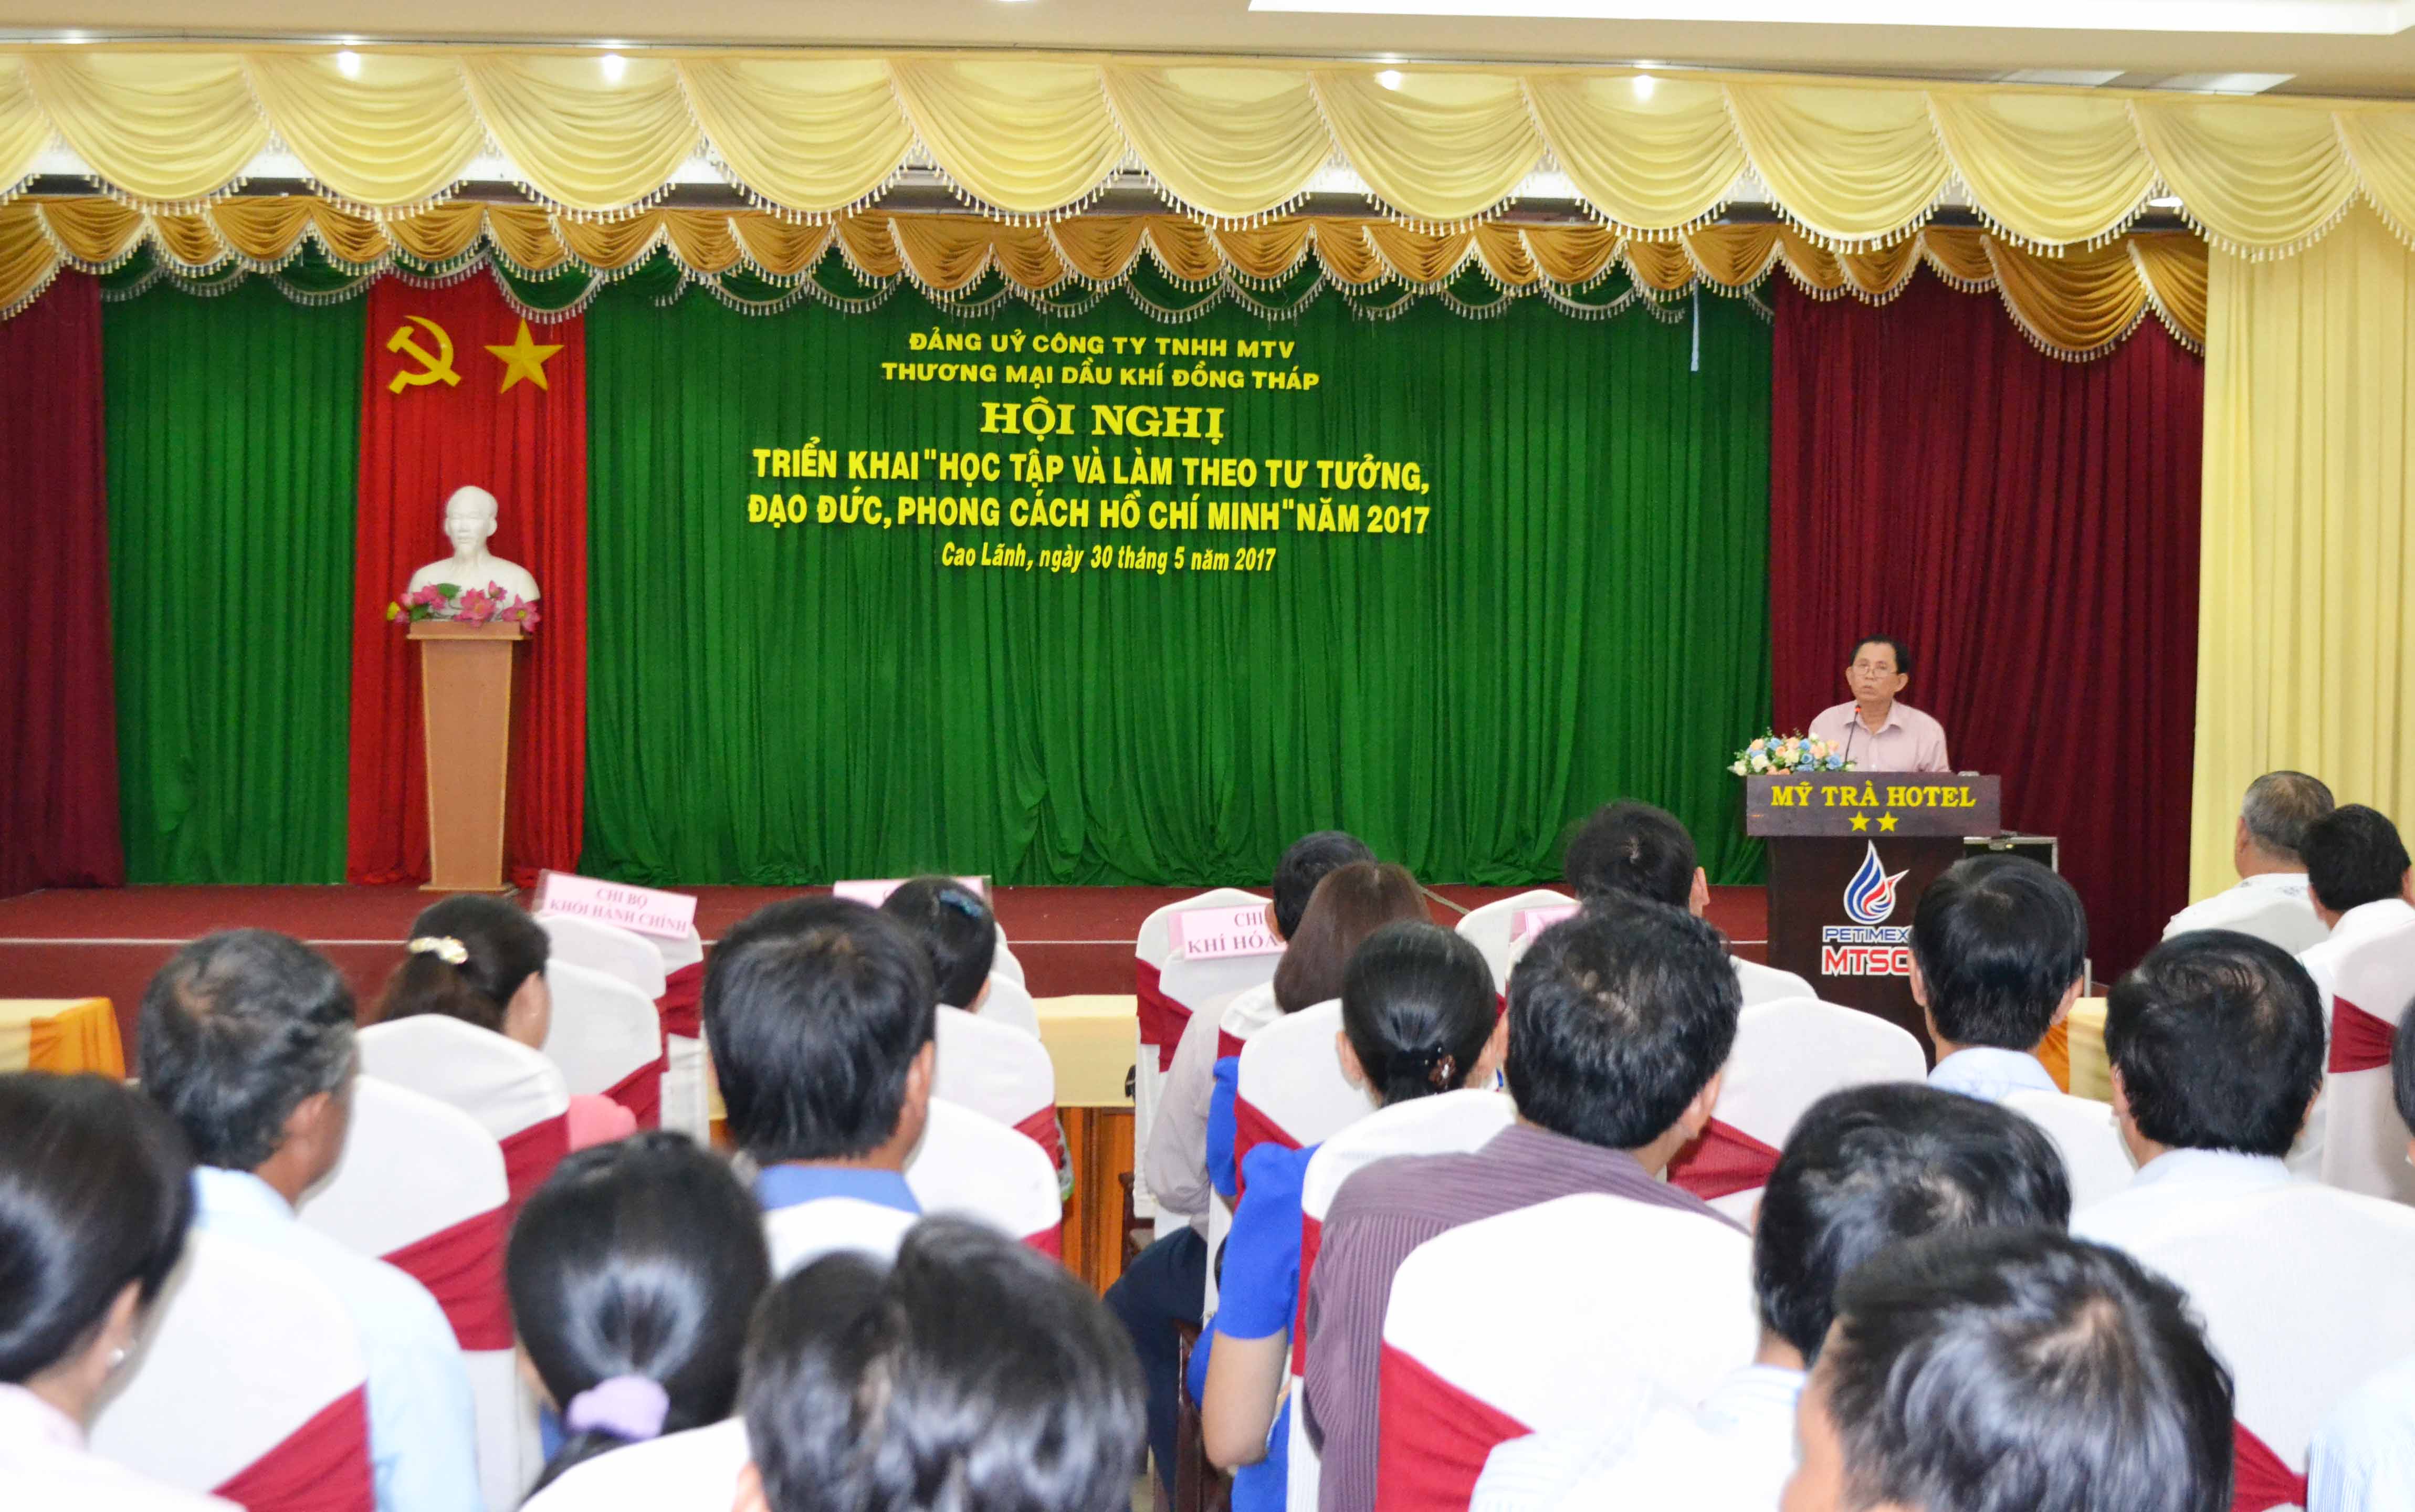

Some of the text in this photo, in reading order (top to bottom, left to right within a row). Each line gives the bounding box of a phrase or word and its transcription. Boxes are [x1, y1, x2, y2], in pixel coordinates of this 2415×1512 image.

[909, 326, 1295, 359] ĐẢNG UỶ CÔNG TY TNHH MTV
[881, 357, 1319, 390] THƯƠNG MẠI DẦU KHÍ ĐỒNG THÁP
[980, 395, 1224, 445] HỘI NGHỊ
[752, 436, 837, 478] TRIỂN
[848, 451, 919, 480] KHAI
[1009, 448, 1064, 488] TẬP
[1072, 446, 1106, 484] VÀ
[1114, 447, 1172, 485] LÀM
[1182, 457, 1257, 487] THEO
[1265, 459, 1309, 488] TƯ
[1316, 453, 1429, 495] TƯỞNG,
[748, 494, 807, 528] ĐẠO
[816, 486, 892, 529] ĐỨC,
[898, 496, 1000, 526] PHONG
[1010, 489, 1089, 527] CÁCH
[1100, 489, 1141, 529] HỒ
[1148, 493, 1200, 530] CHÍ
[1297, 497, 1359, 532] NĂM
[1367, 505, 1430, 534] 2017
[942, 541, 1276, 575] Cao Lãnh, ngày 30 tháng 5 năm 2017
[1770, 779, 1977, 807] MỸ TRÀ HOTEL
[595, 887, 649, 909] CHI BỘ
[1234, 911, 1263, 927] CHI
[1823, 926, 1913, 942] PETIMEX
[1188, 933, 1226, 953] KHÍ
